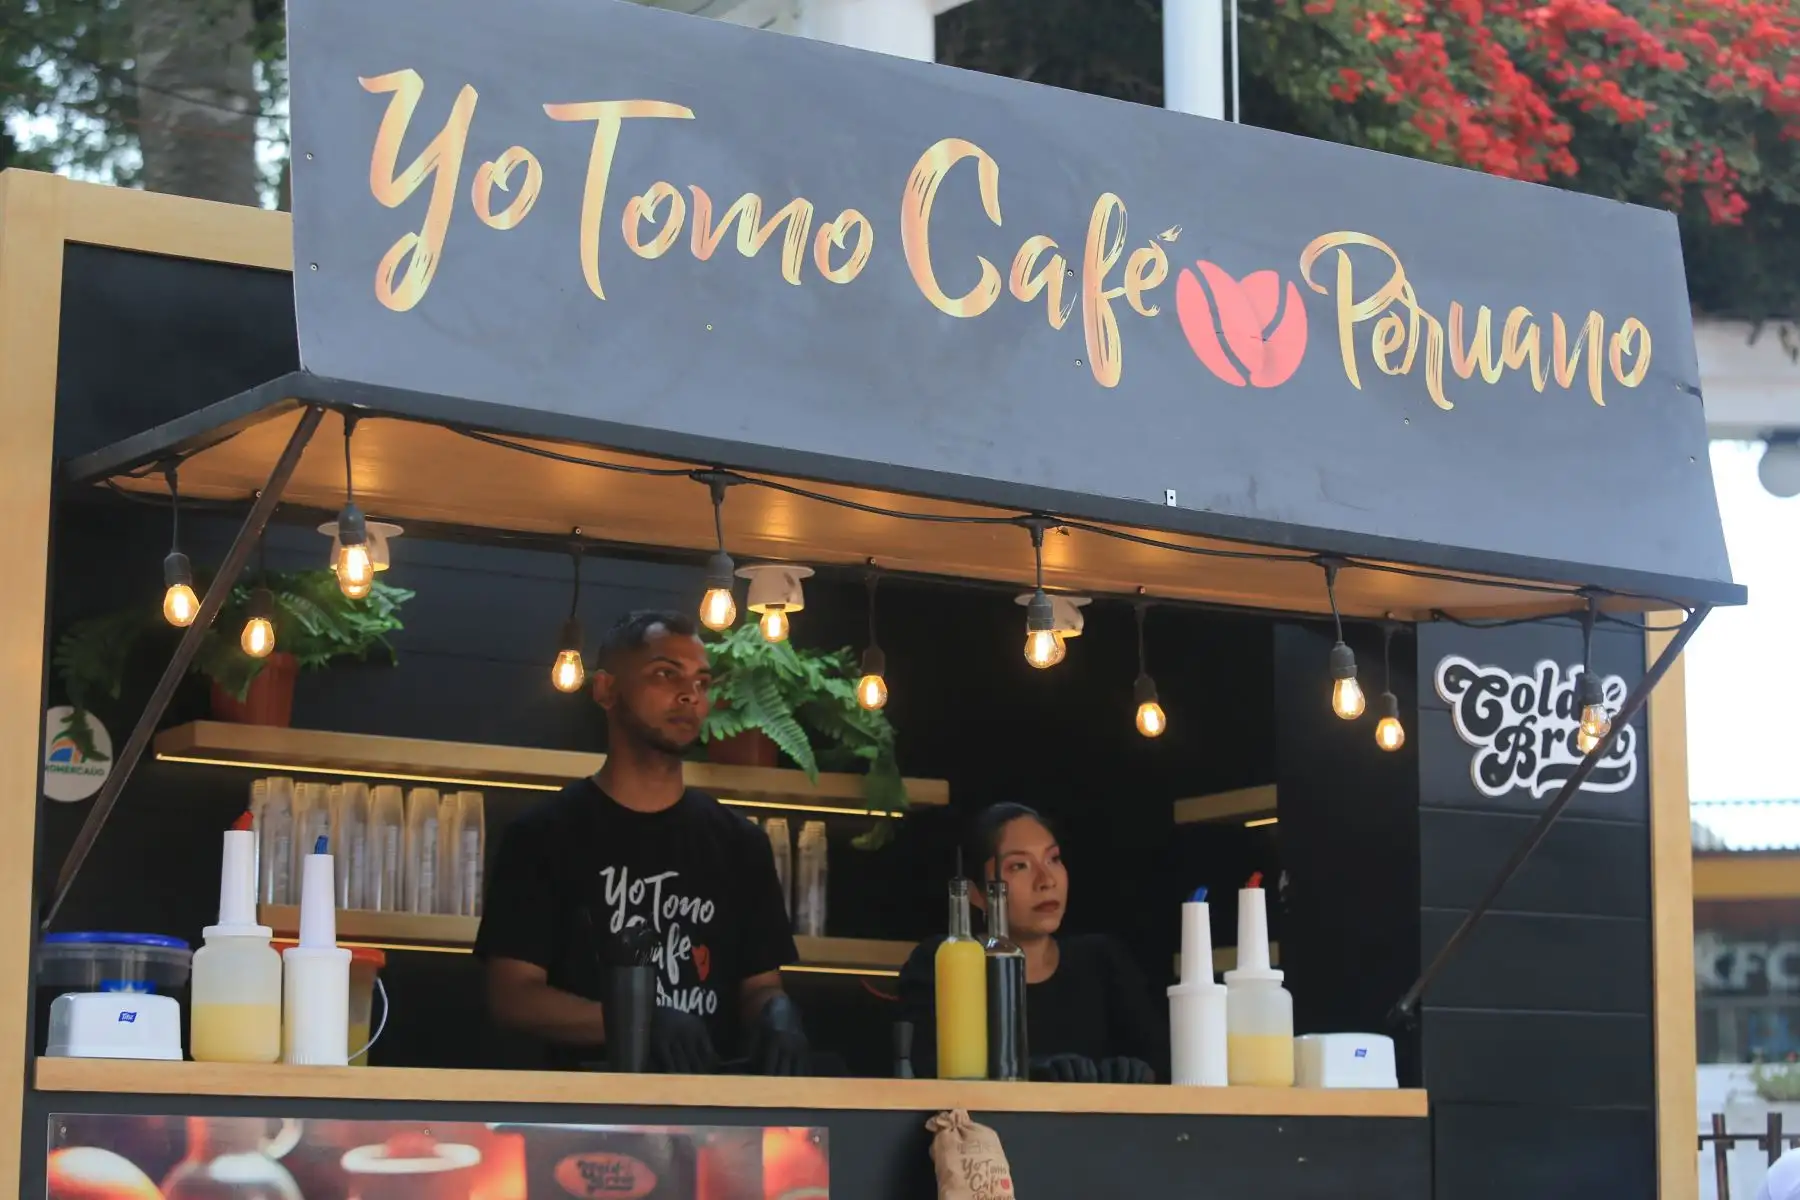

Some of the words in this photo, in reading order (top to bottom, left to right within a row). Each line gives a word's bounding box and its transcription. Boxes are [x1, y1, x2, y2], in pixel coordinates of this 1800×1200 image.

[358, 68, 542, 312] Yo
[543, 98, 873, 300] Tomo
[901, 137, 1183, 388] Café
[1300, 230, 1652, 410] Peruano
[1443, 664, 1584, 737] Cold
[600, 865, 645, 933] Yo
